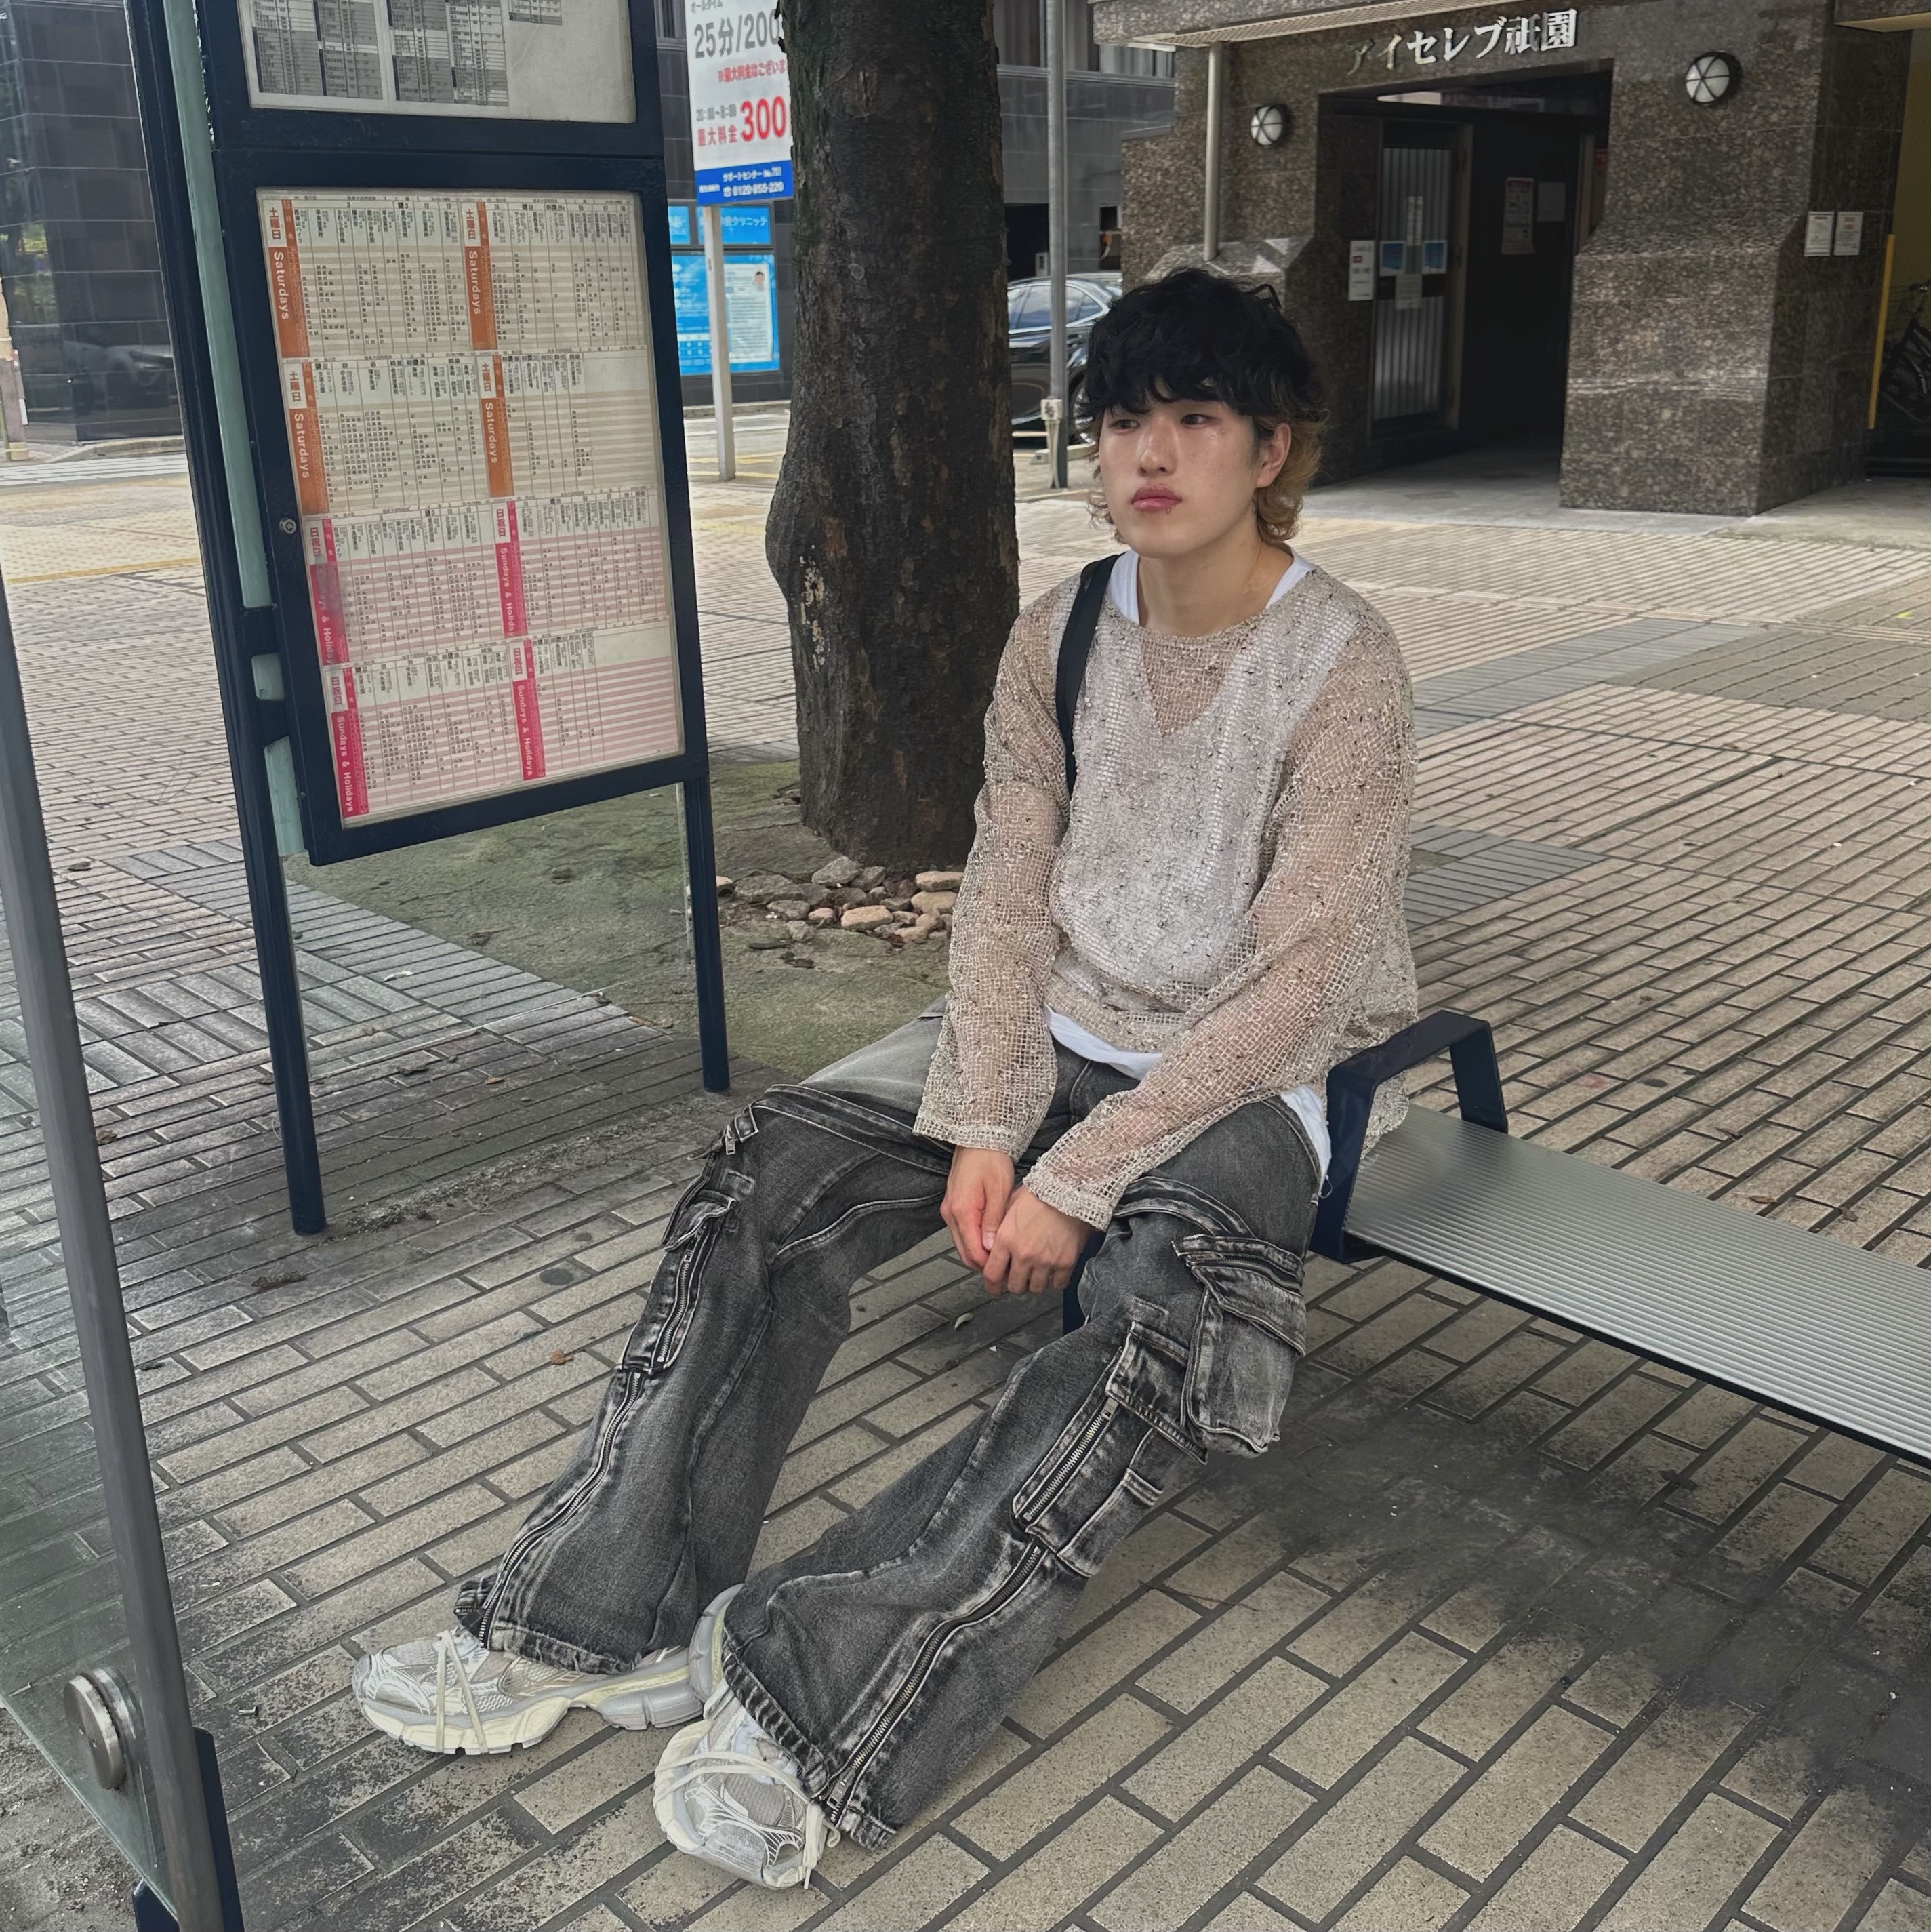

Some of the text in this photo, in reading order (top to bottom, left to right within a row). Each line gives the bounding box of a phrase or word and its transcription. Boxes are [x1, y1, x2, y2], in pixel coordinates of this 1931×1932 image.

[1347, 9, 1577, 75] アイセレブ祇園
[697, 125, 737, 146] 最大料金
[740, 96, 786, 142] 300
[274, 251, 289, 320] Saturdays
[469, 250, 481, 315] Saturdays
[294, 413, 310, 479] Saturdays
[485, 402, 498, 464] Saturdays
[500, 548, 510, 588] Sundays
[518, 685, 527, 723] Sundays
[524, 738, 533, 776] Holidays
[337, 716, 348, 757] Sundays
[344, 772, 354, 813] Holidays
